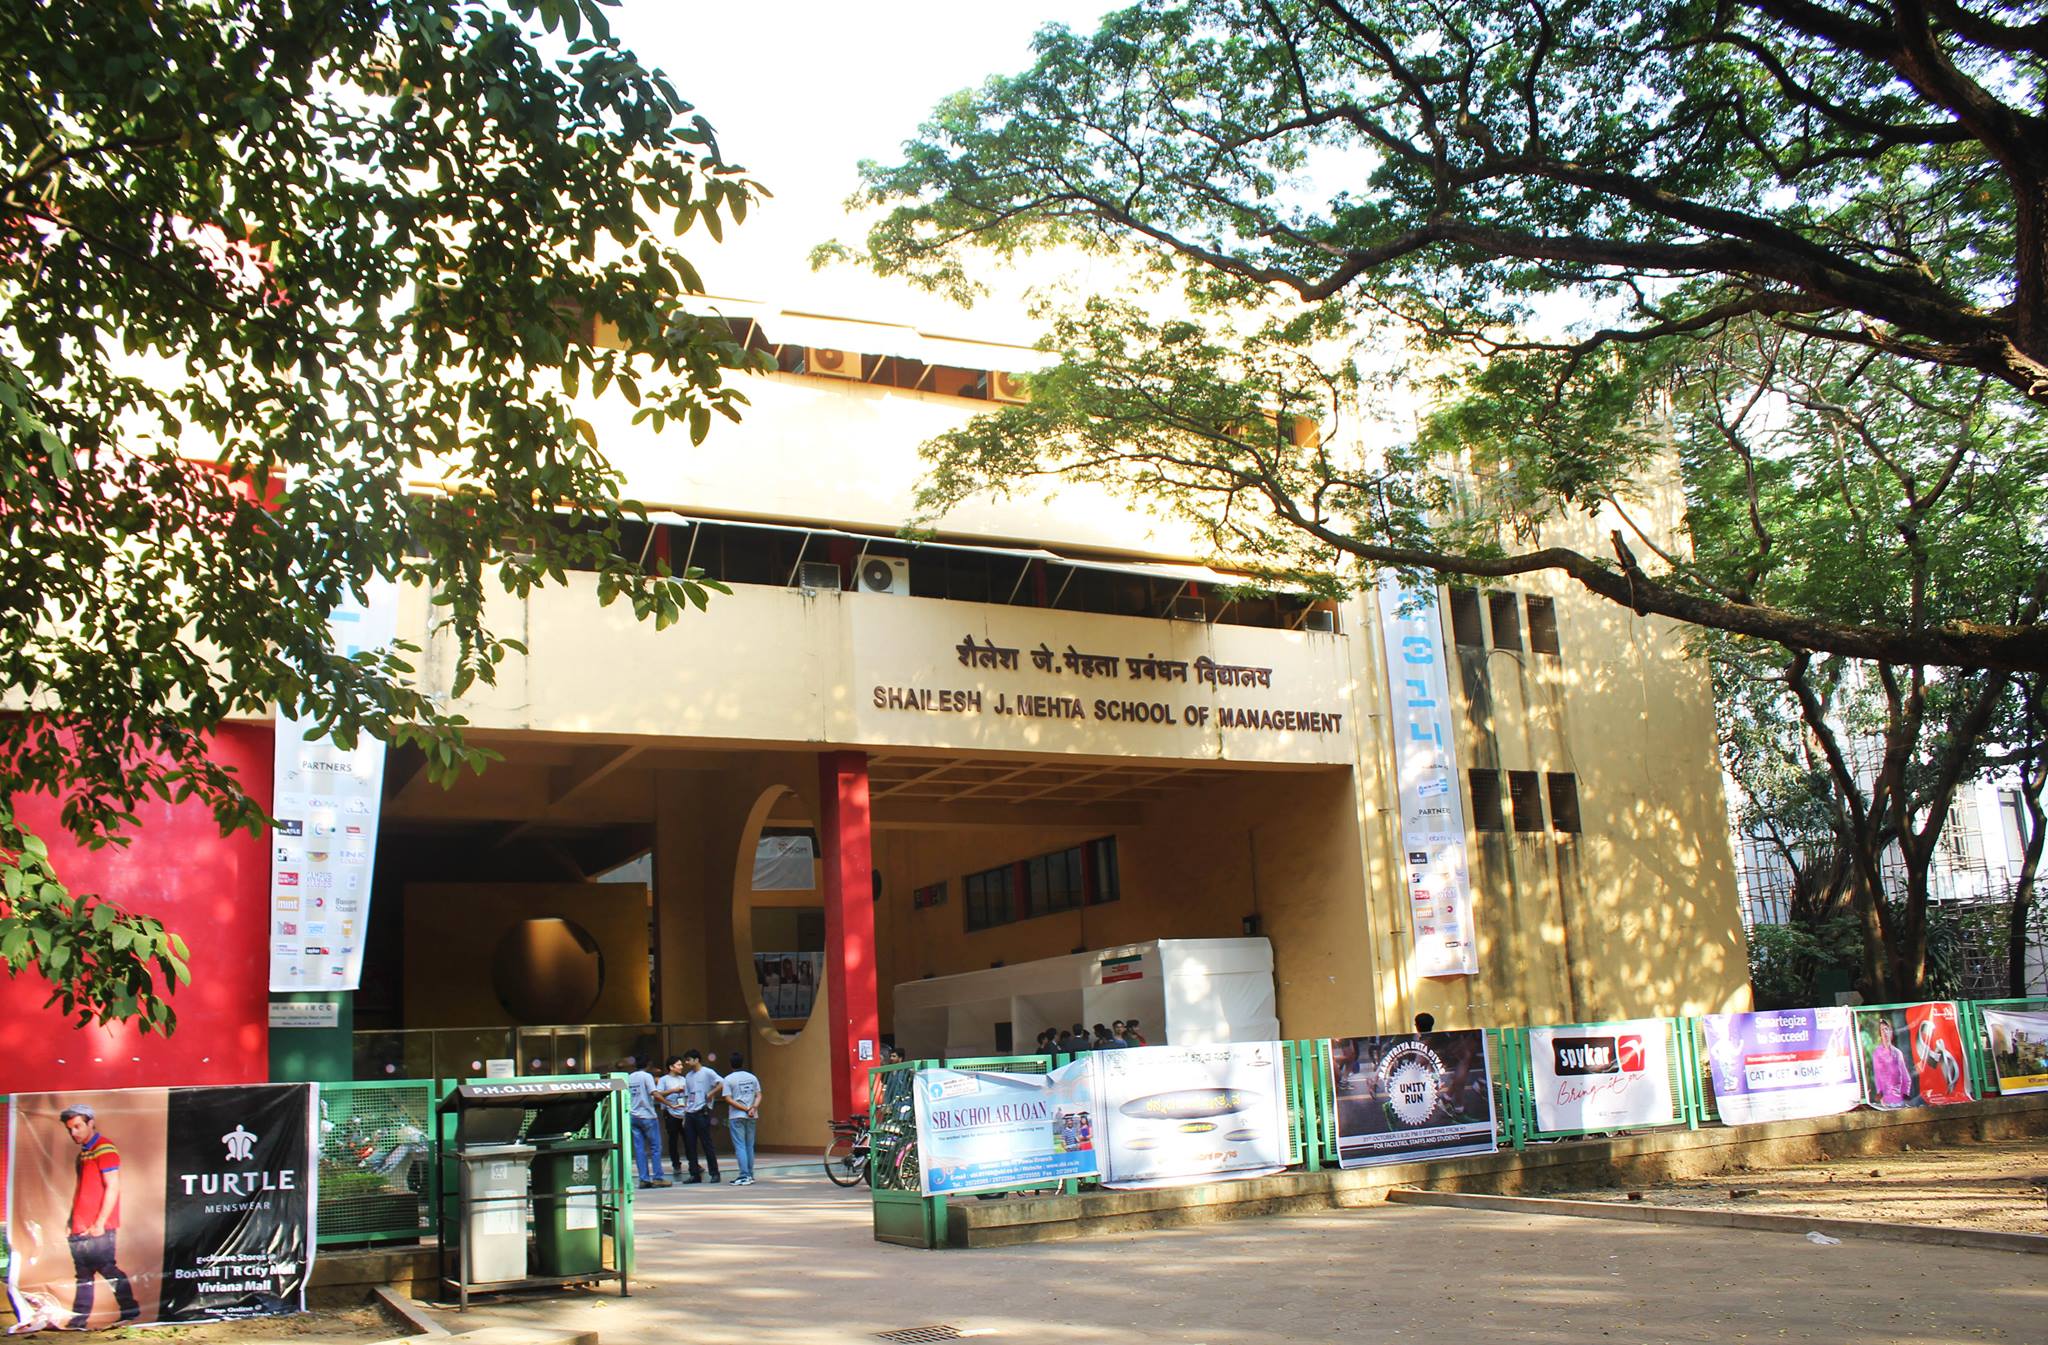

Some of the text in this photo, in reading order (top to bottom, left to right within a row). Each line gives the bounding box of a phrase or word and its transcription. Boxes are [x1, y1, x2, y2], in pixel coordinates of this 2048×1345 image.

[956, 634, 1020, 670] शैलेश
[1125, 653, 1188, 683] प्रबंधन
[1194, 656, 1273, 689] विद्यालय
[873, 685, 981, 713] SHAILESH
[1094, 699, 1176, 724] SCHOOL
[1184, 704, 1209, 725] OF
[1218, 706, 1343, 734] MANAGEMENT
[302, 760, 352, 773] PARTNERS
[1755, 1013, 1808, 1030] Smartegize
[1768, 1030, 1809, 1044] Succeed!
[1559, 1043, 1610, 1069] spykar
[1750, 1069, 1765, 1082] CAT
[548, 1081, 613, 1092] BOMBAY
[1399, 1082, 1427, 1094] UNITY
[1405, 1093, 1424, 1105] RUN
[932, 1099, 1048, 1130] SBI SCHOLAR LOAN
[181, 1169, 296, 1197] TURTLE
[204, 1202, 271, 1214] MENSWEAR
[237, 1253, 267, 1262] Stores
[243, 1265, 269, 1278] City
[197, 1280, 272, 1293] Viviana Mall
